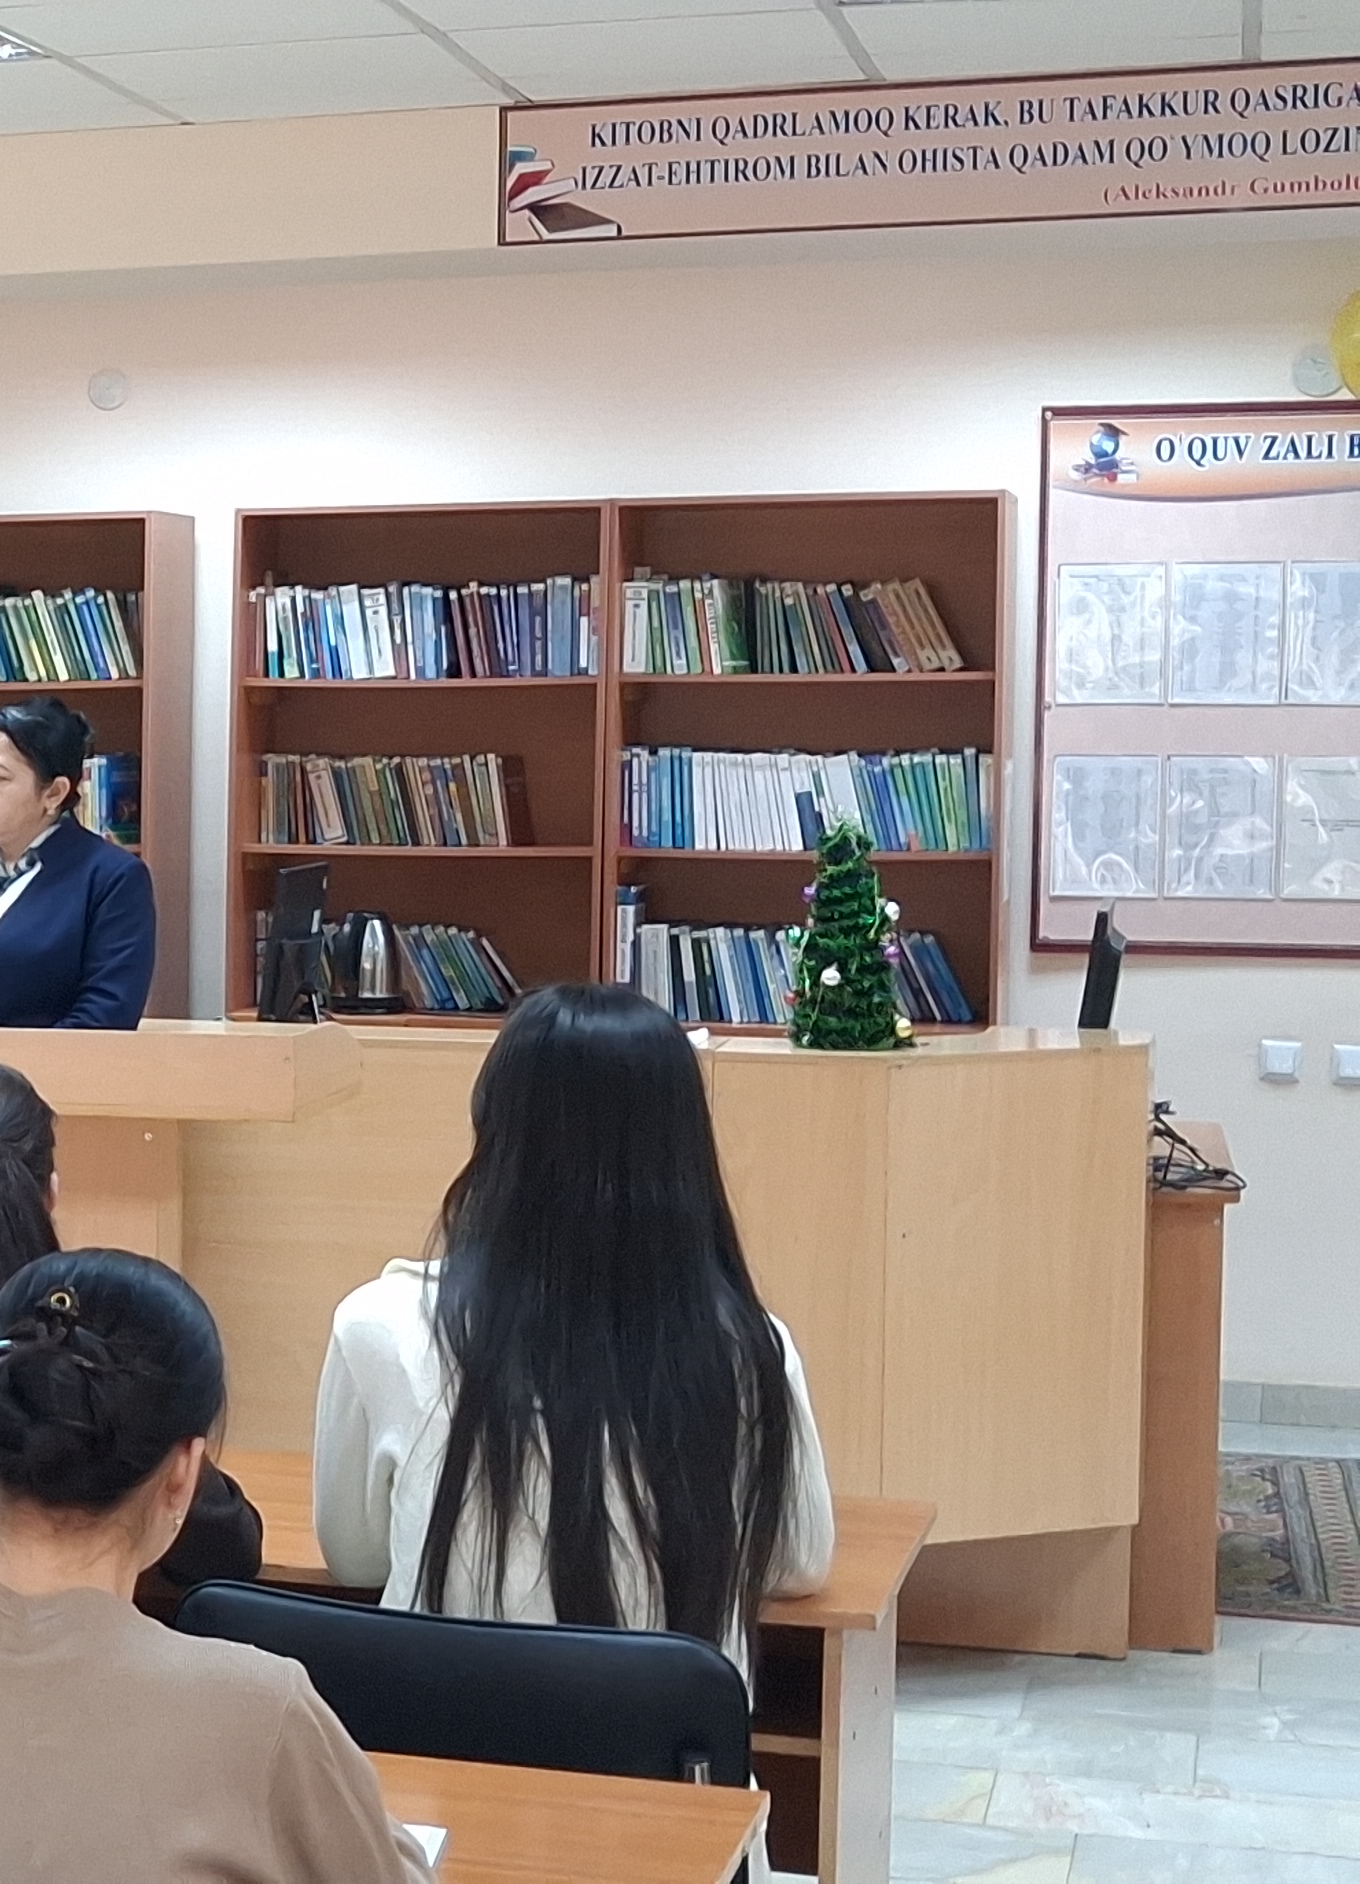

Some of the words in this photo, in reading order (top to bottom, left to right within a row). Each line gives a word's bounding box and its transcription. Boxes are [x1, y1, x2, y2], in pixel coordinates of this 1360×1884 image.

[590, 117, 703, 149] KITOBNI
[711, 106, 895, 147] QADRLAMOQ
[903, 100, 1009, 131] KERAK,
[1018, 98, 1055, 126] BU
[1063, 89, 1221, 123] TAFAKKUR
[580, 154, 796, 191] IZZAT-EHTIROM
[806, 149, 889, 179] BILAN
[898, 145, 1002, 175] OHISTA
[1009, 137, 1116, 174] QADAM
[1281, 125, 1360, 156] LOZI
[1103, 179, 1242, 206] (Aleksandr
[1155, 433, 1252, 468] O'QUV
[1261, 434, 1336, 461] ZALI
